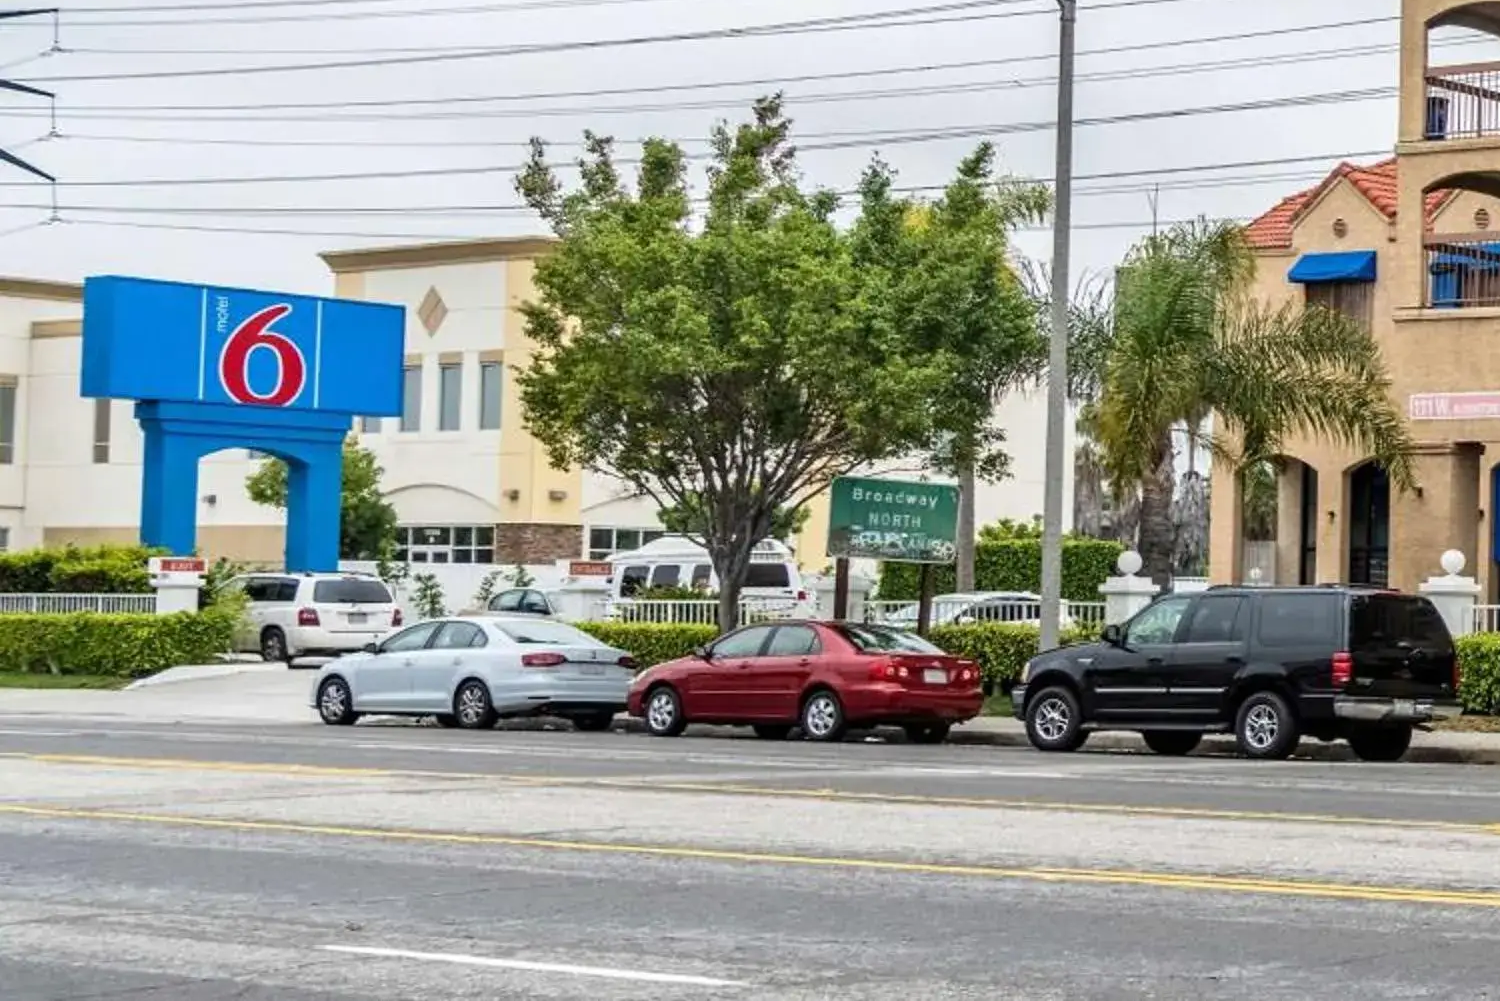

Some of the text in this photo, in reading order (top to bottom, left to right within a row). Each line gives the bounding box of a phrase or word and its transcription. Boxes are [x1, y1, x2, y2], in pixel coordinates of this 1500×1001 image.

[216, 296, 229, 333] motel
[218, 302, 307, 407] 6
[852, 486, 938, 510] Broadway
[868, 511, 921, 528] NORTH
